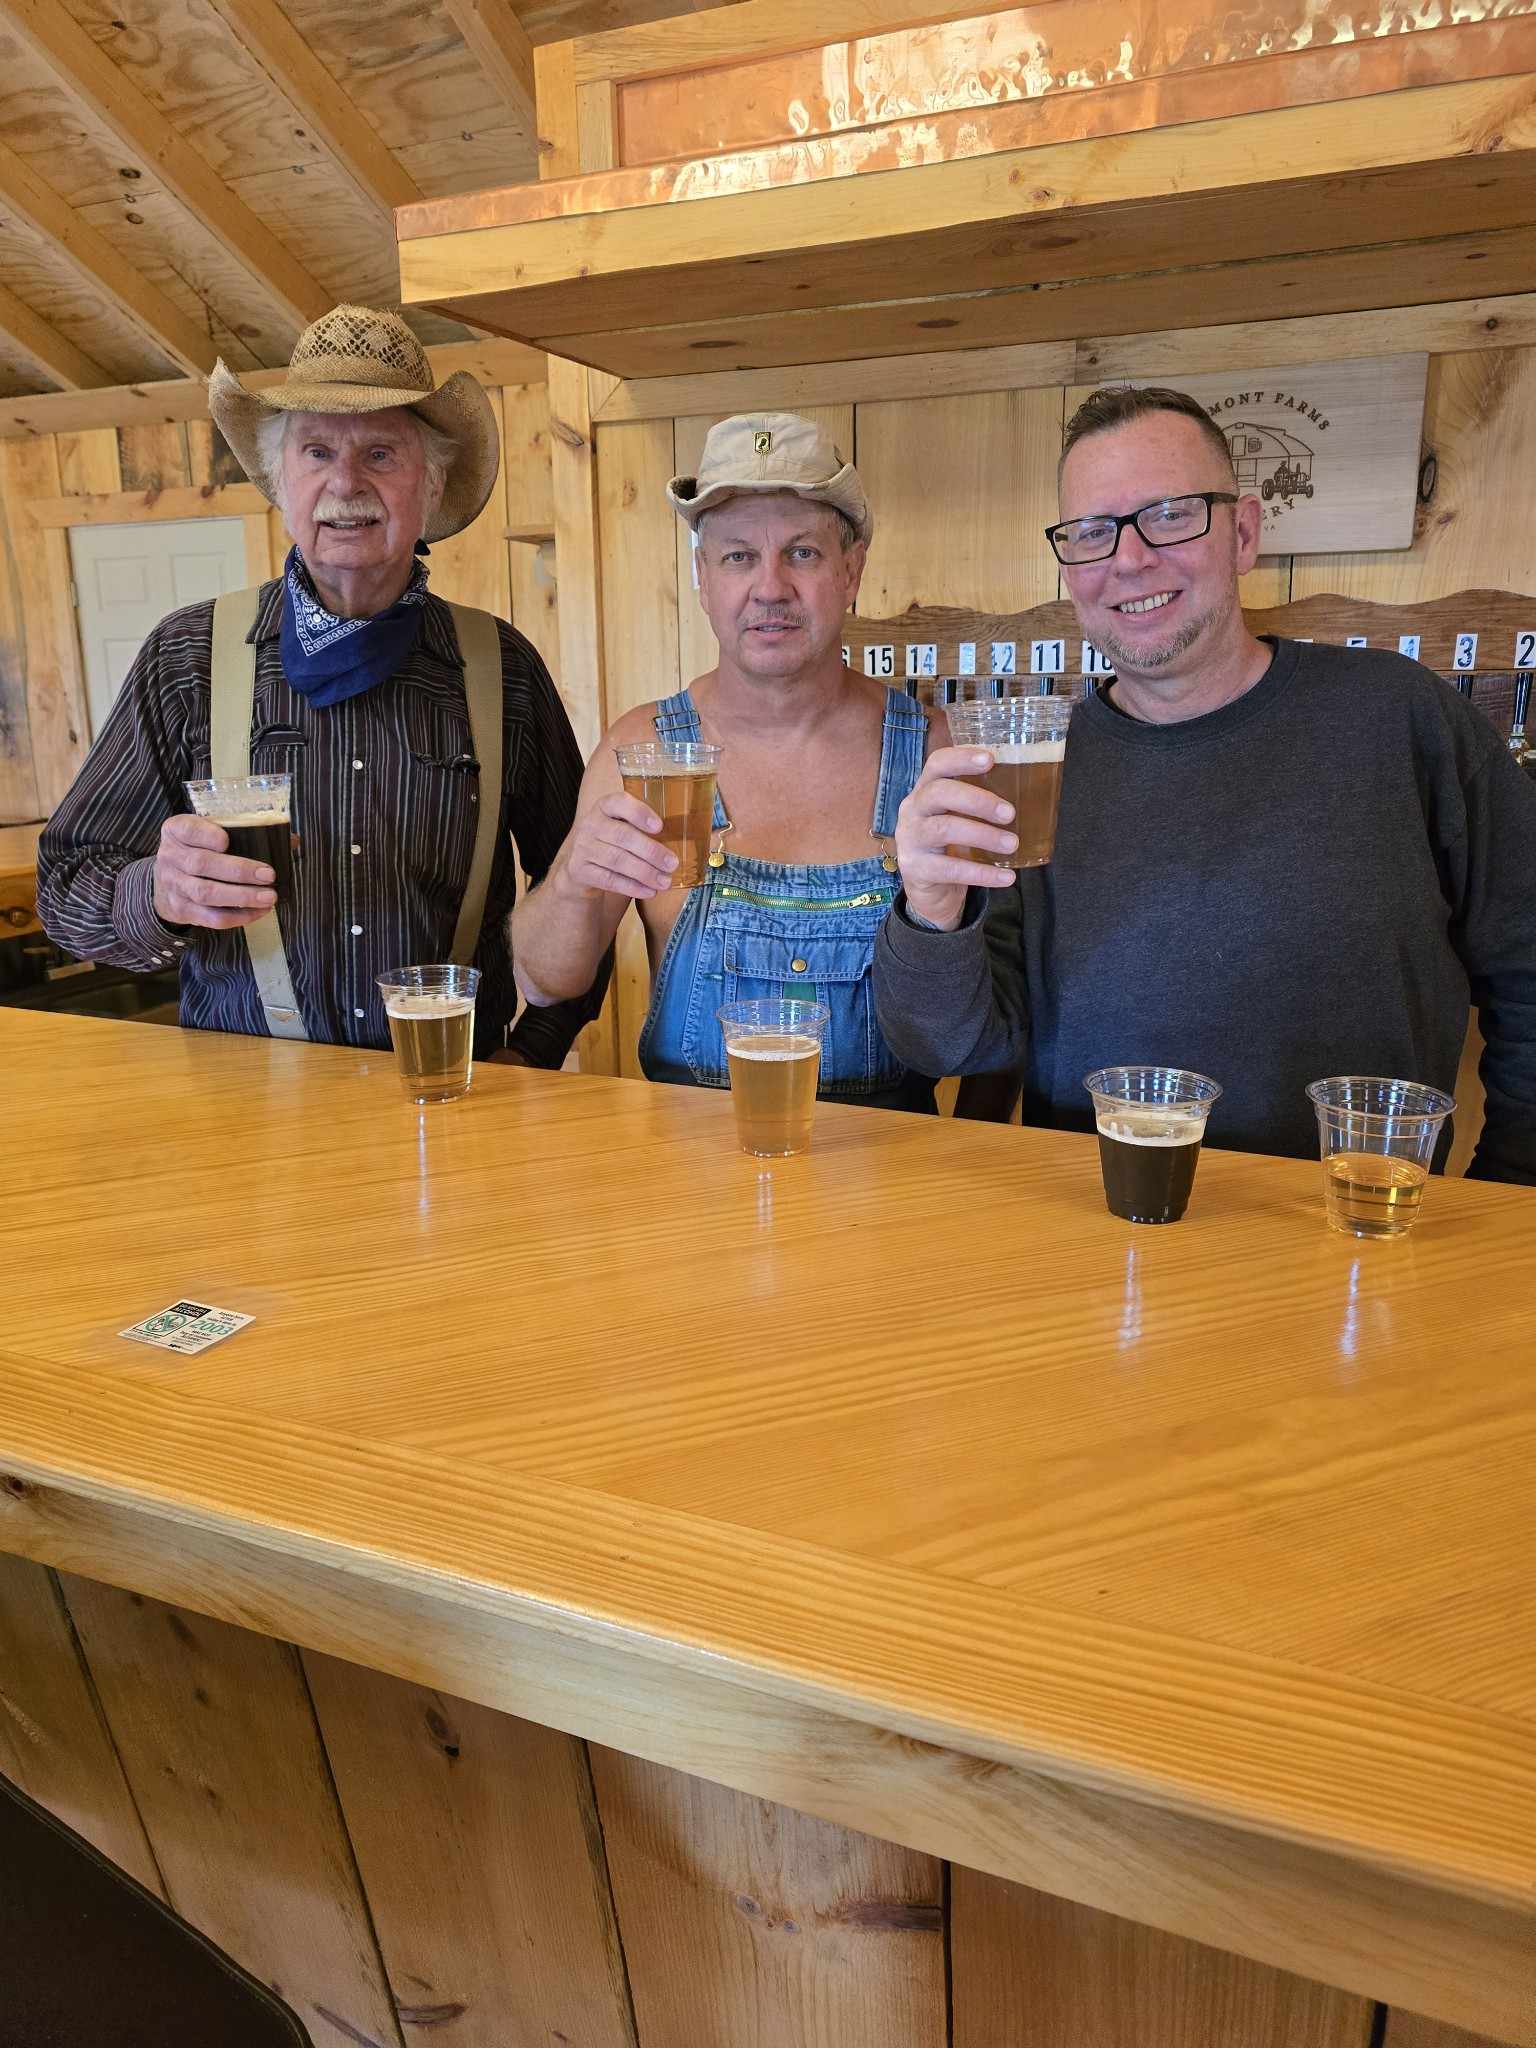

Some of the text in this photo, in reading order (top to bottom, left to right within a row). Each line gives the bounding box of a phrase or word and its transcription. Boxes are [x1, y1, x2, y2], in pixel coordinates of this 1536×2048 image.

[1273, 392, 1331, 431] FARMS
[868, 647, 892, 675] 15
[910, 646, 935, 674] 14
[1036, 641, 1061, 672] 11
[1456, 636, 1474, 668] 3
[1517, 634, 1535, 667] 2
[190, 1319, 234, 1336] 2003
